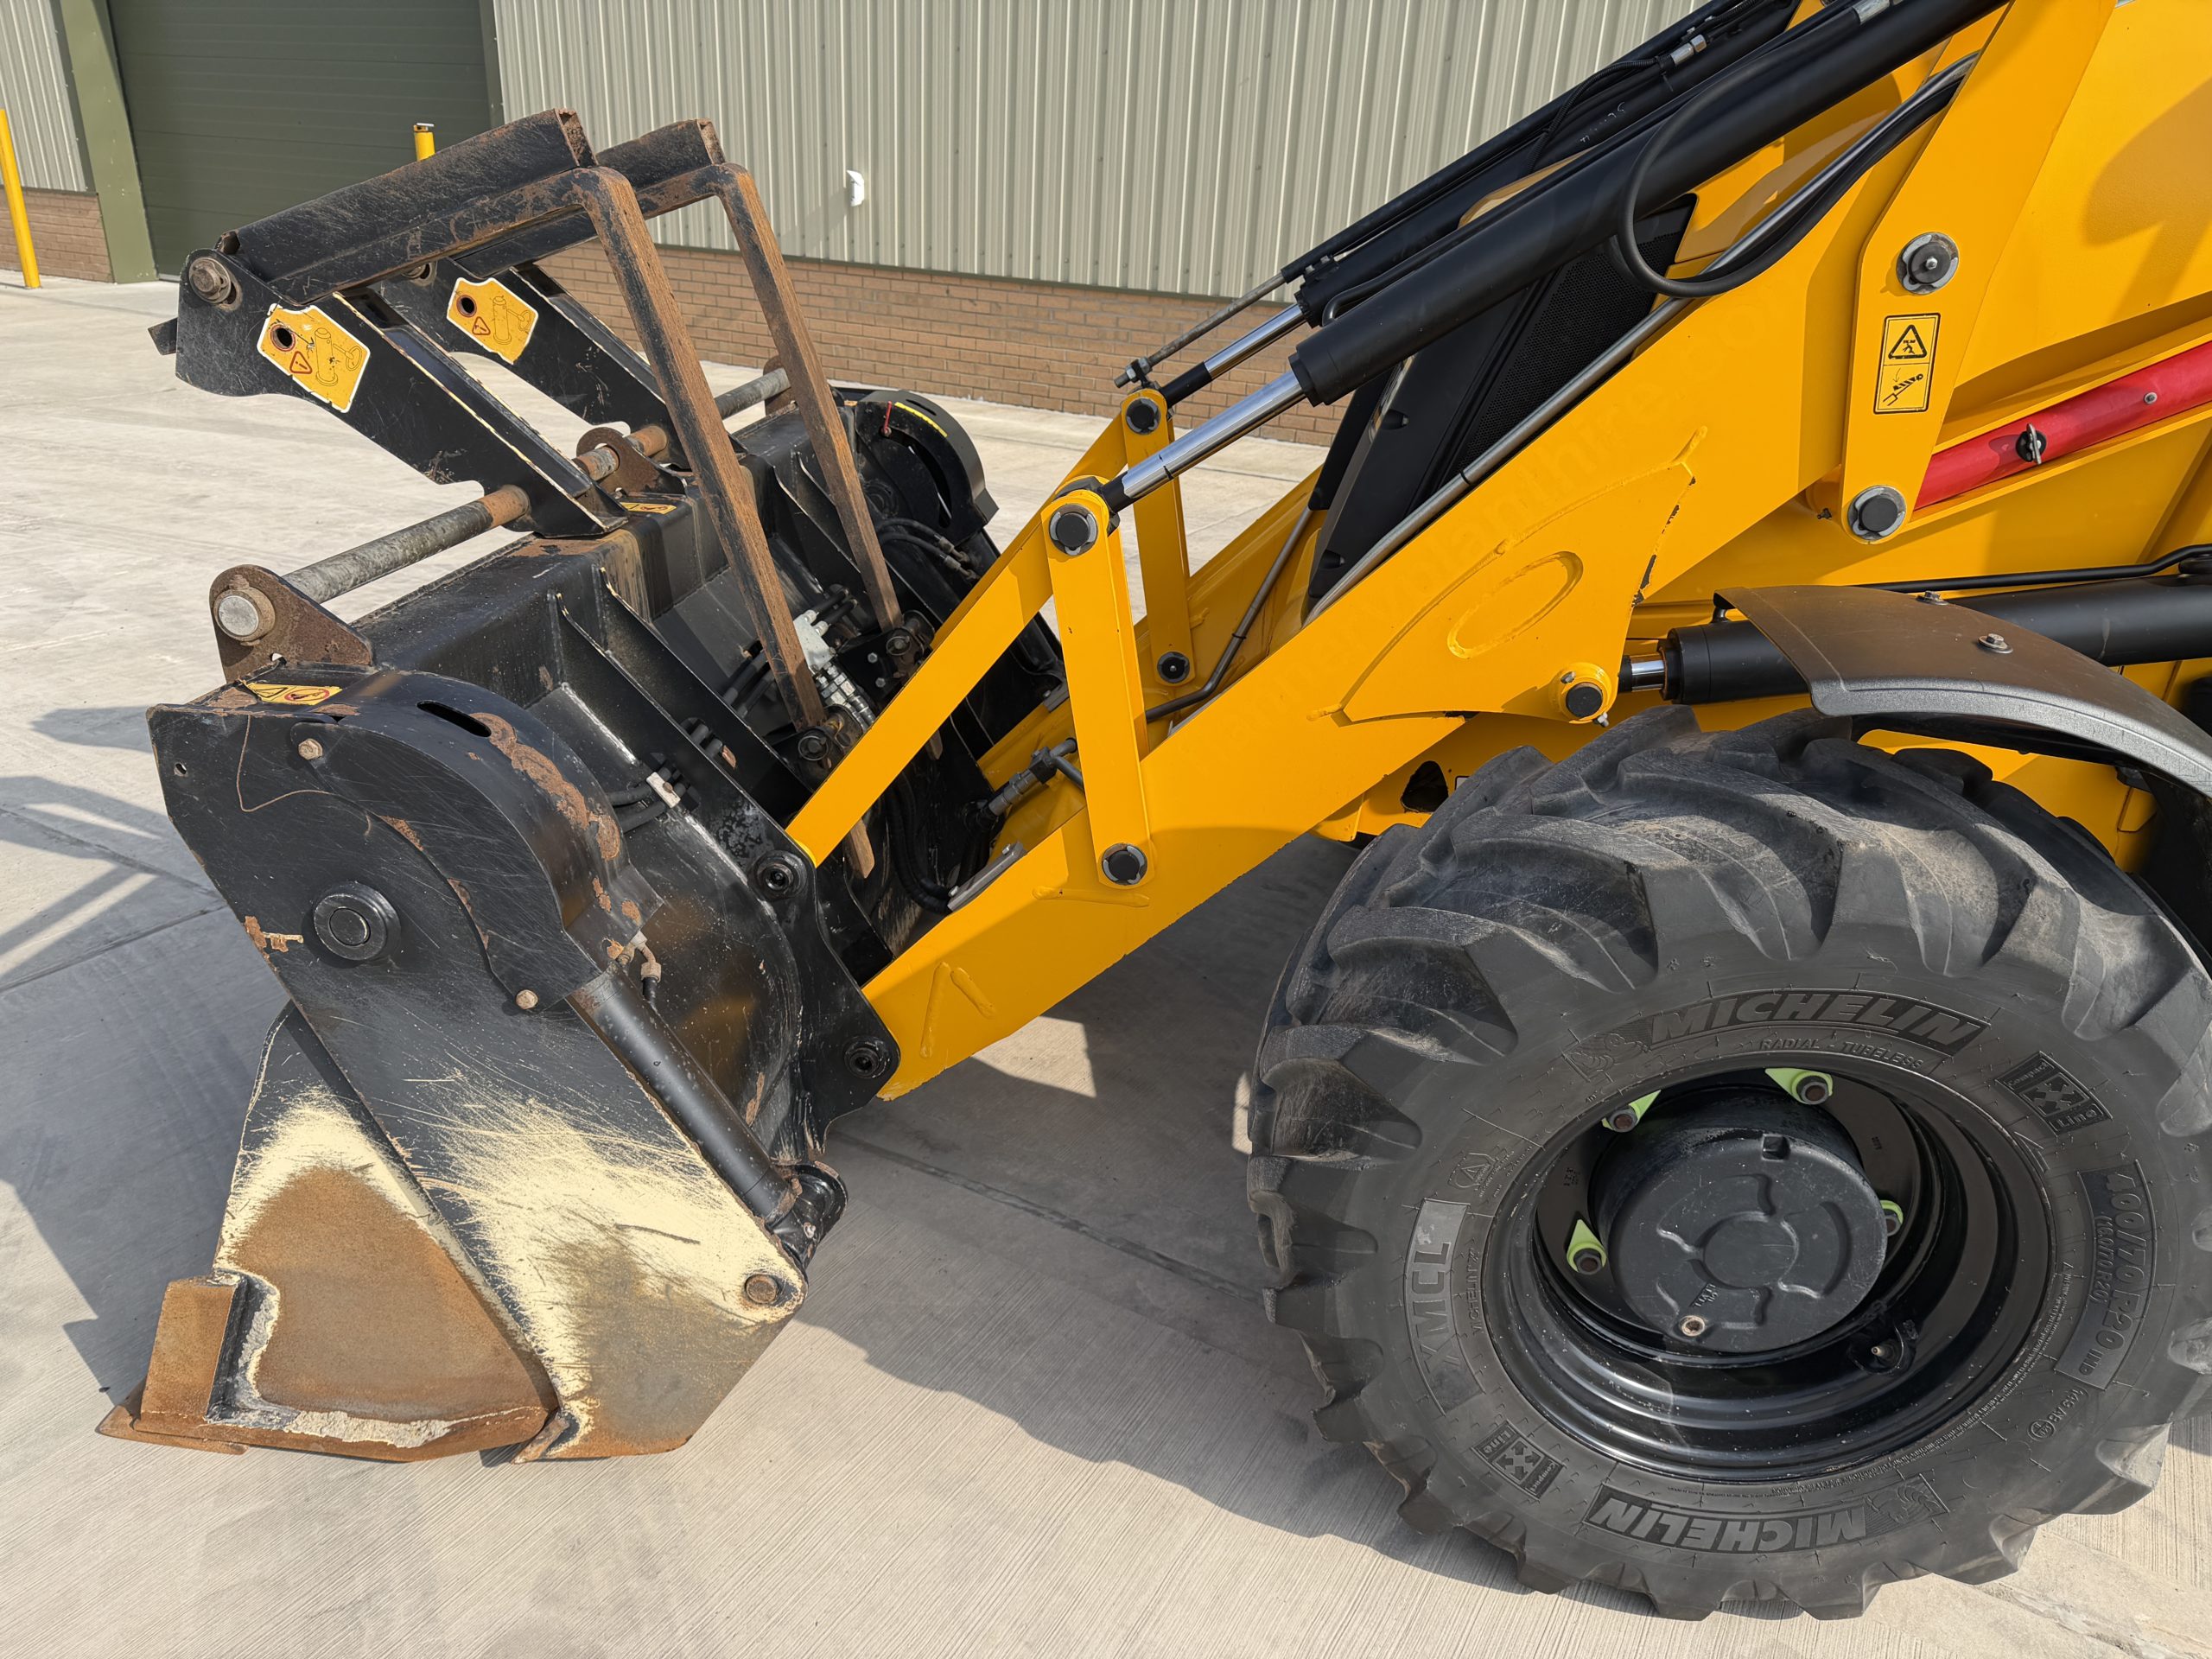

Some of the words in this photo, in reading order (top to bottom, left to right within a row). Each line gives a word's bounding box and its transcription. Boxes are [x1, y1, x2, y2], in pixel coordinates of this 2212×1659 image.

[1649, 992, 1983, 1047] MICHELIN
[1759, 1038, 1820, 1051] RADIAL
[1841, 1040, 1924, 1070] TUBELESS
[2056, 1108, 2098, 1129] Line
[2105, 1173, 2147, 1284] 400/70
[2078, 1348, 2103, 1376] IND
[1483, 1430, 1510, 1453] Line
[1589, 1497, 1867, 1552] MICHELIN
